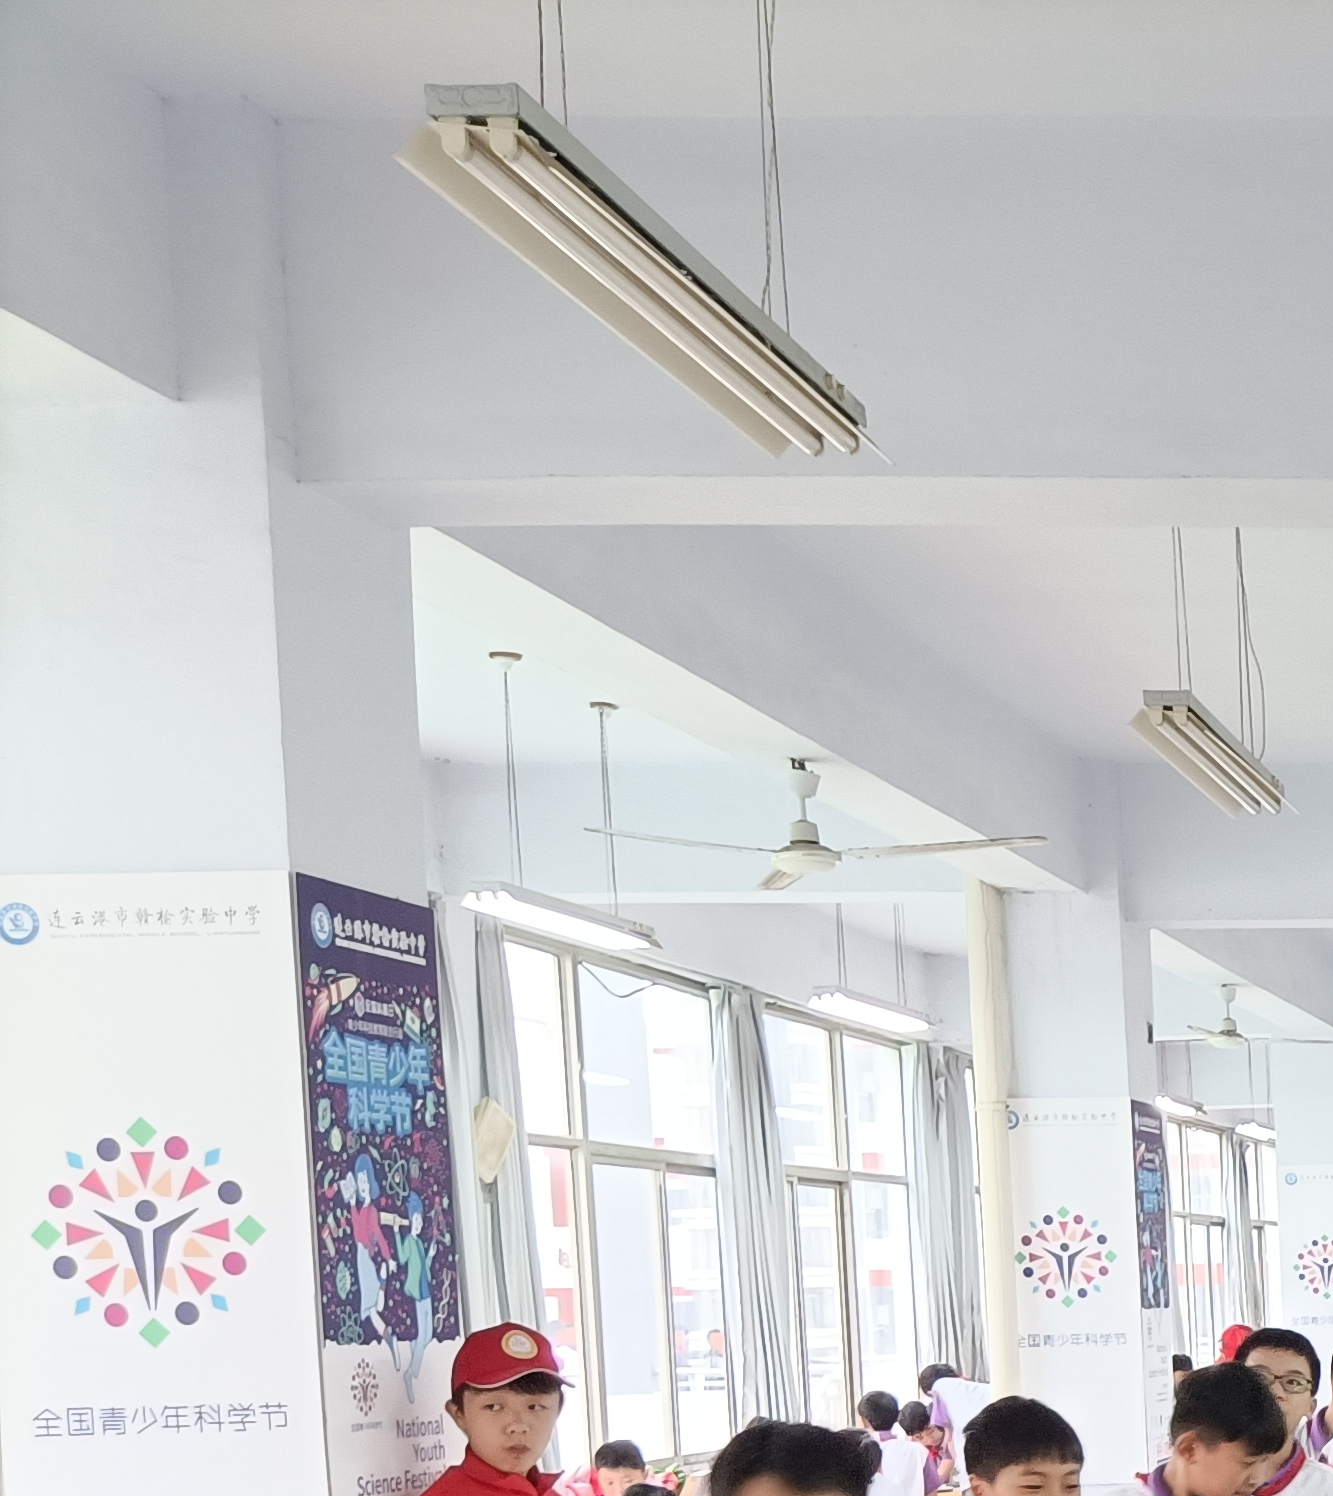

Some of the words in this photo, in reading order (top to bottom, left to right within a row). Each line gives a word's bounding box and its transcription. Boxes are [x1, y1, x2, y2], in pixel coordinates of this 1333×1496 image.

[325, 1030, 430, 1094] 全国青少年
[348, 1086, 413, 1136] 科学节
[32, 1402, 288, 1437] 全国青少年科学节
[396, 1413, 444, 1439] National
[412, 1442, 446, 1463] Youth
[404, 1465, 447, 1490] Festiv
